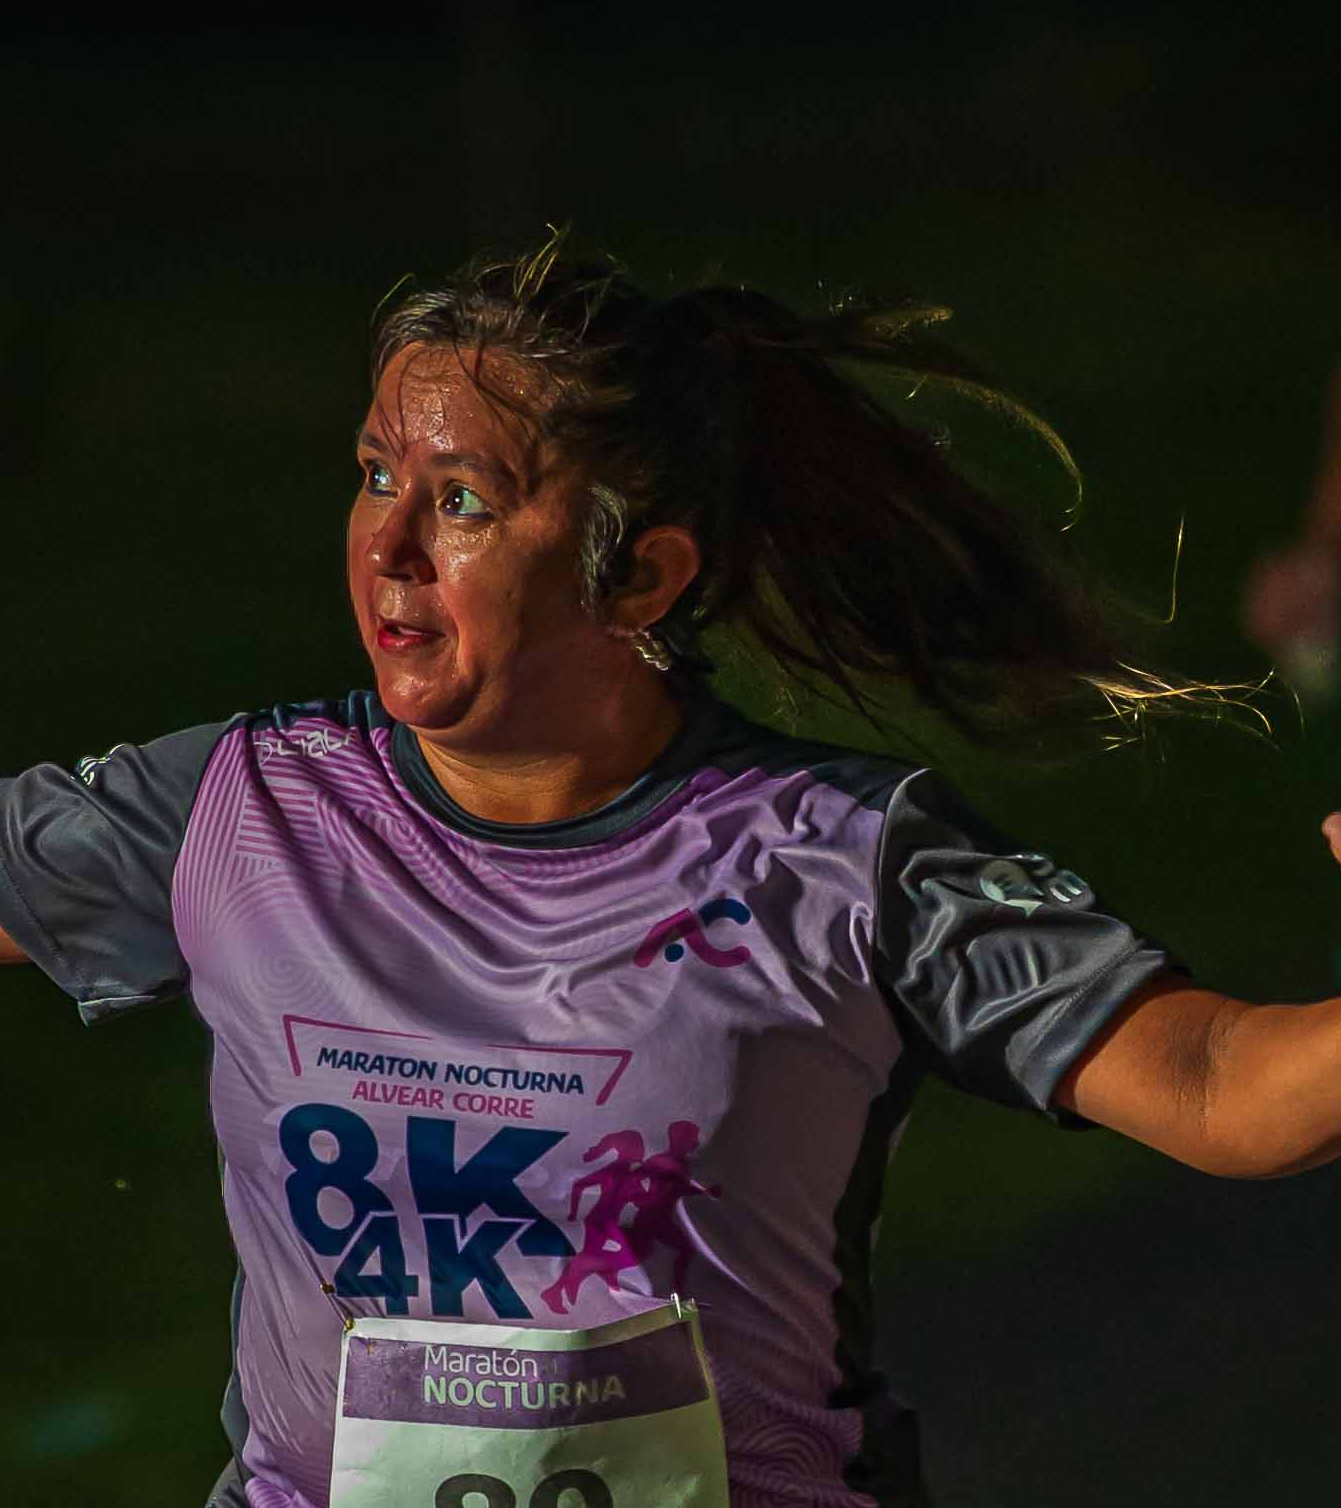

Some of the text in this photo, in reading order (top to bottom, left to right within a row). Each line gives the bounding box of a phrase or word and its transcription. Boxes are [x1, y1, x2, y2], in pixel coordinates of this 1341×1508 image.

[316, 1046, 585, 1095] MARATON NOCTURNA
[351, 1079, 535, 1119] ALVEAR CORRE
[278, 1102, 577, 1257] 8K
[333, 1213, 535, 1320] 4K
[423, 1344, 539, 1378] Maratón
[422, 1373, 628, 1411] NOCTURNA
